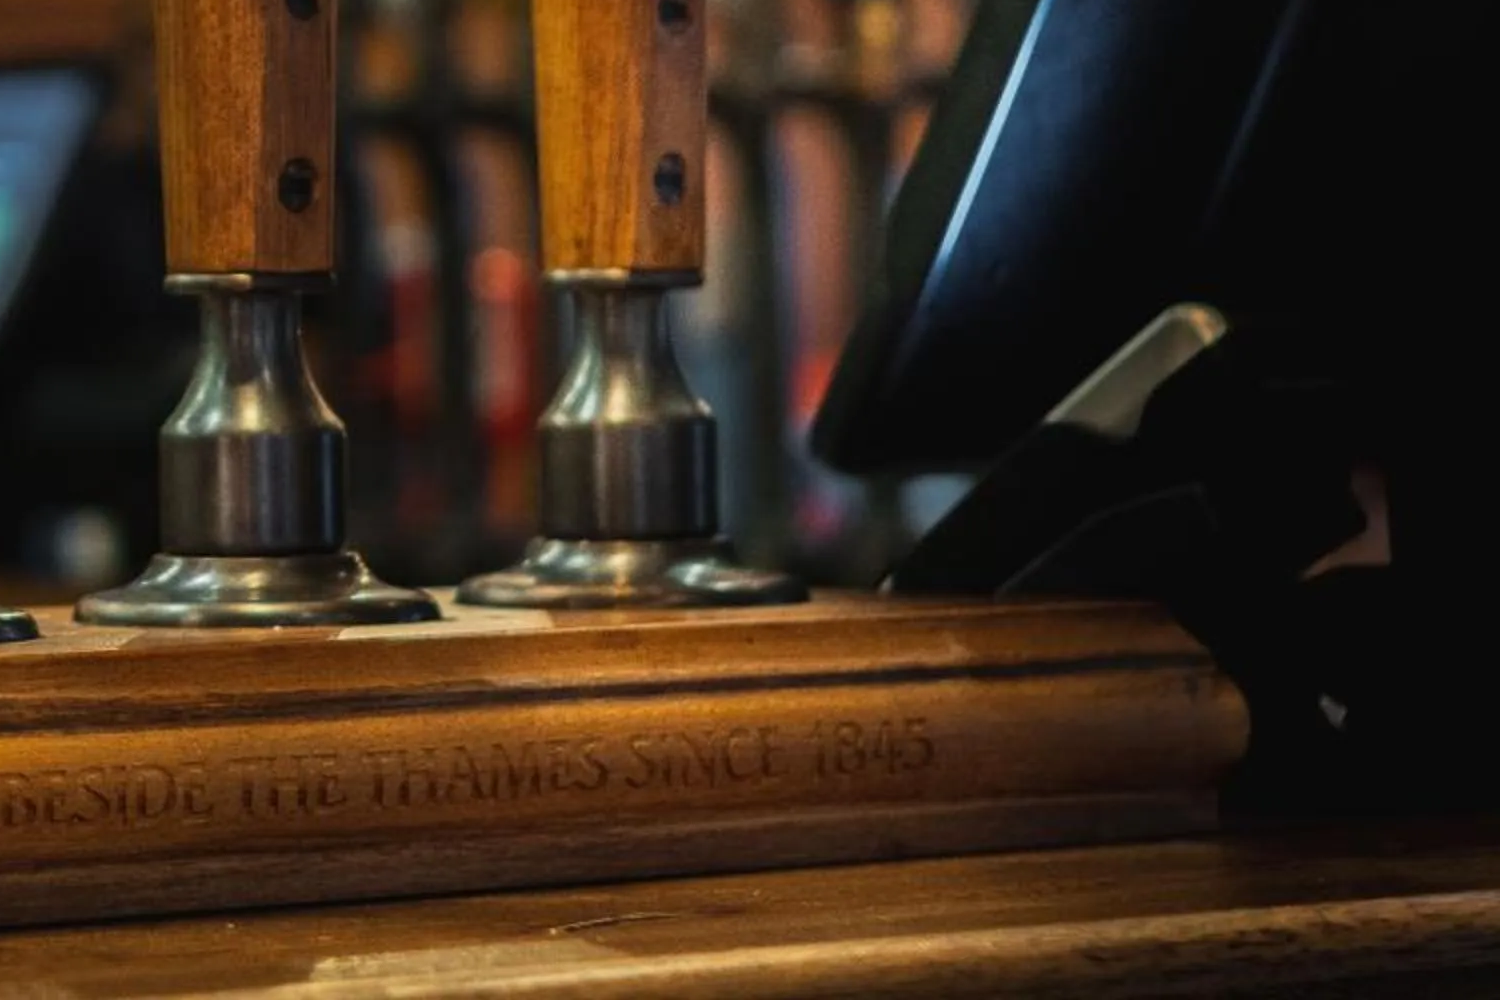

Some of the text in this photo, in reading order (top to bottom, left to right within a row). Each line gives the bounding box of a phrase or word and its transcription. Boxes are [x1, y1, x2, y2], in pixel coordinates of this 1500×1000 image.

[227, 752, 347, 816] THE
[364, 735, 610, 808] THAMES
[624, 725, 790, 789] SINCE
[805, 717, 936, 776] 1845
